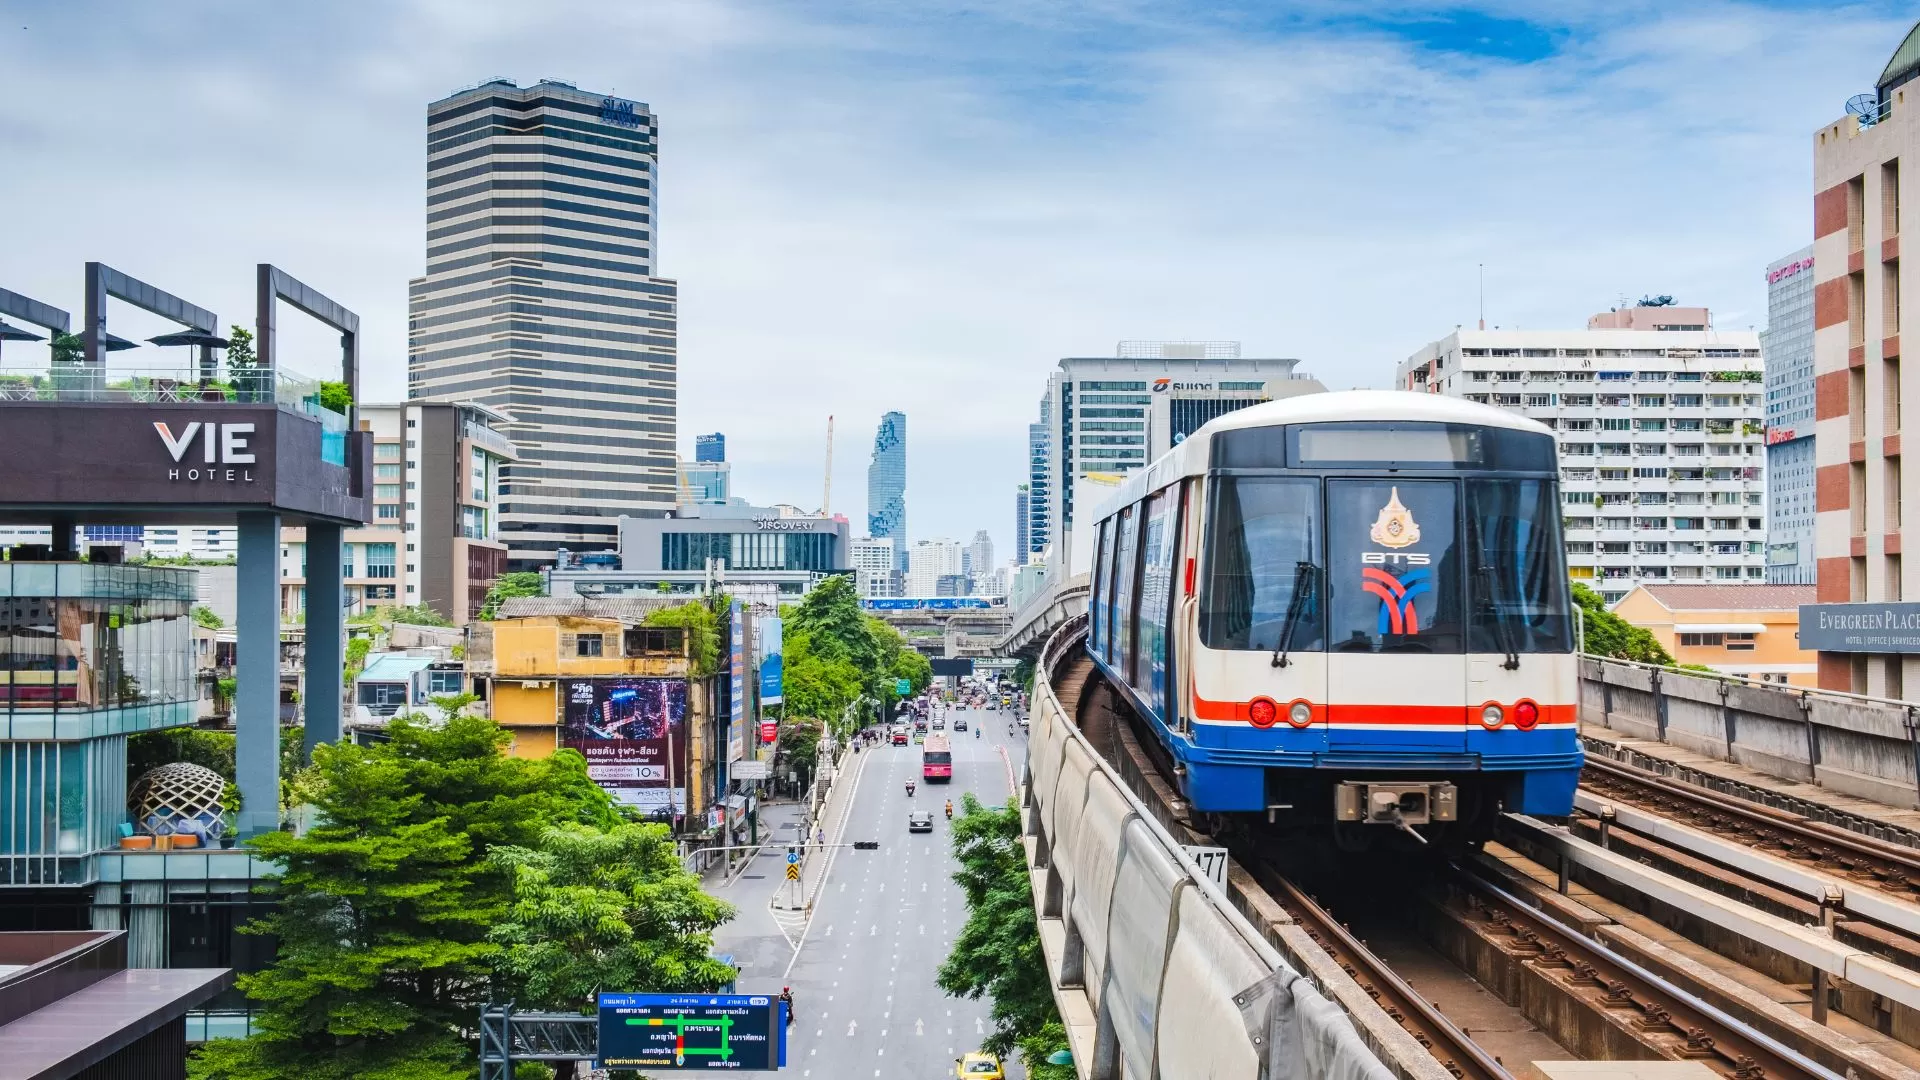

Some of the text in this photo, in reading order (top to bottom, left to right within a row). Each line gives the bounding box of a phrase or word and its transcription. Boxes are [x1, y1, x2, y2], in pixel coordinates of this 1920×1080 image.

[152, 421, 256, 464] VIE
[169, 469, 253, 481] HOTEL
[757, 520, 815, 530] DISCOVERY
[1361, 551, 1431, 565] BTS
[1845, 636, 1863, 645] HOTEL
[1867, 636, 1887, 645] OFFICE
[636, 767, 651, 777] 10
